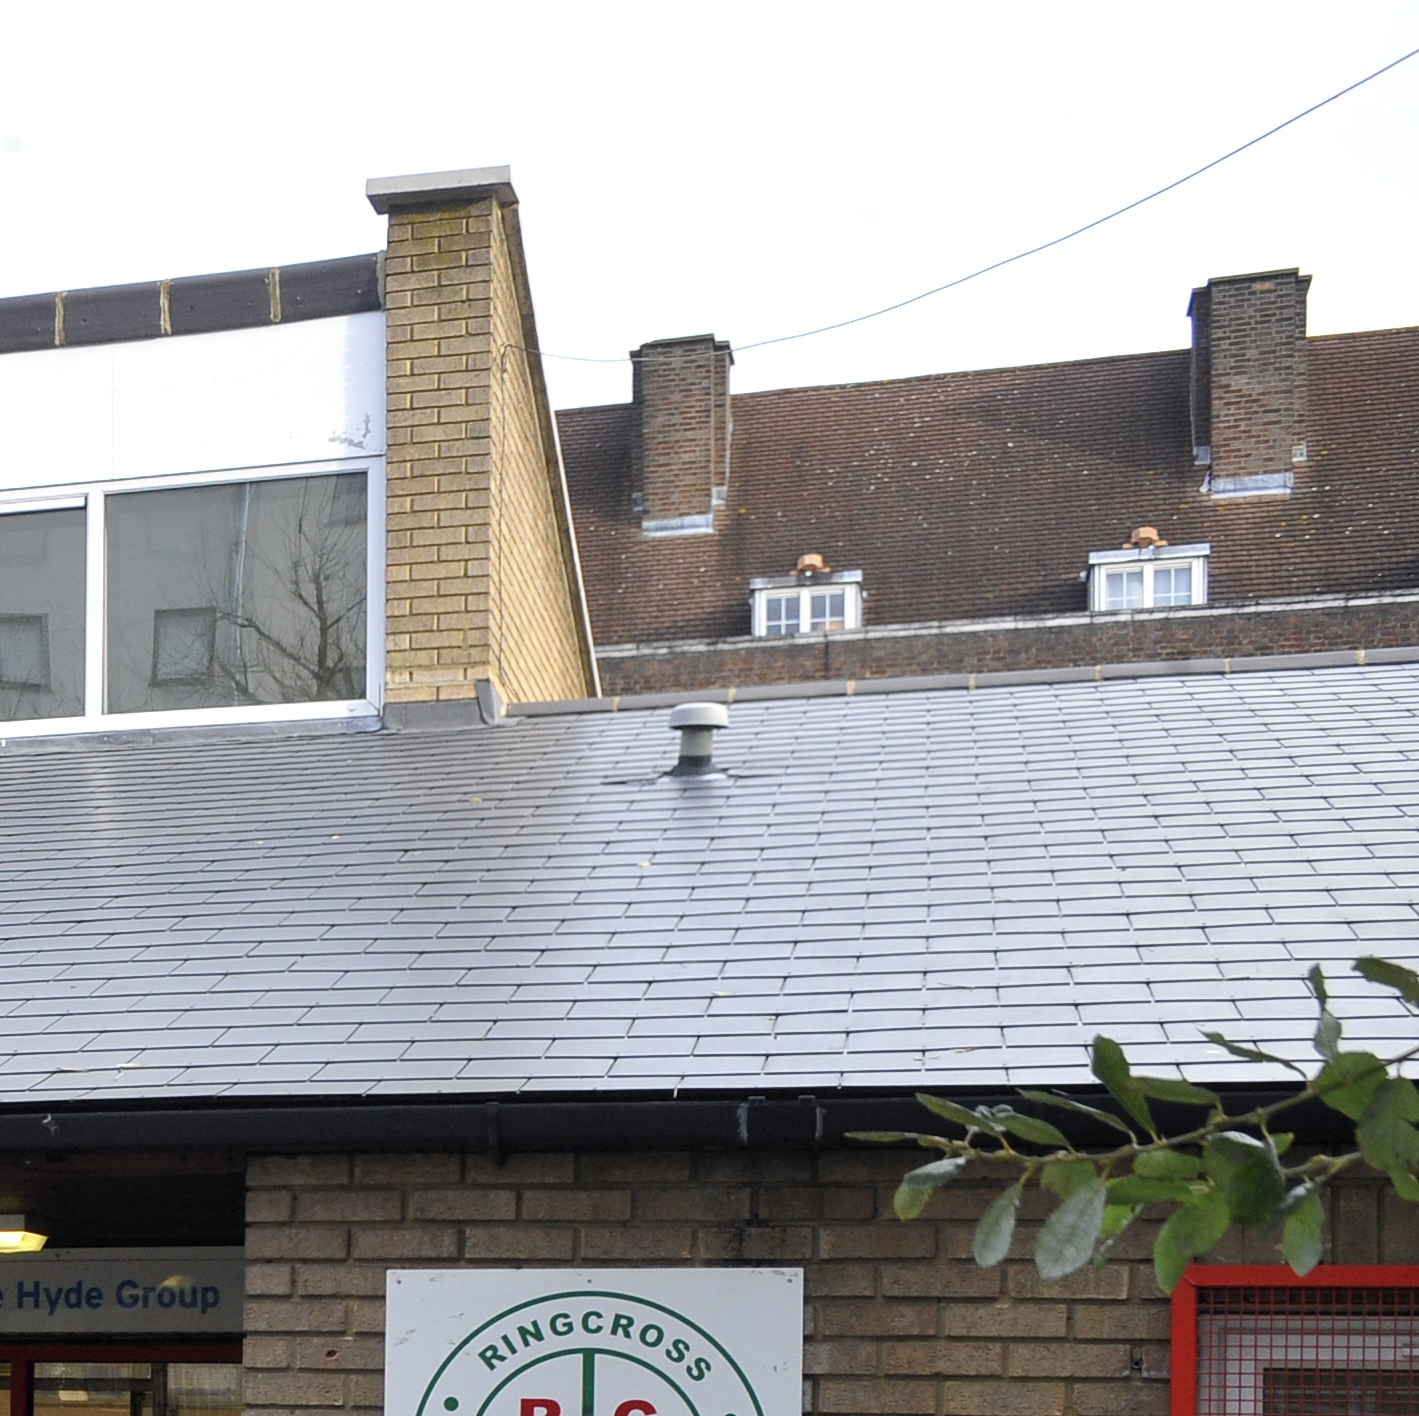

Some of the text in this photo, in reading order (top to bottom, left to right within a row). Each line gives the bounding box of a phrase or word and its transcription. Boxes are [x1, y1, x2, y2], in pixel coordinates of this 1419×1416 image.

[17, 1280, 103, 1316] Hyde
[116, 1280, 220, 1314] Group
[477, 1310, 712, 1381] RINGCROSS
